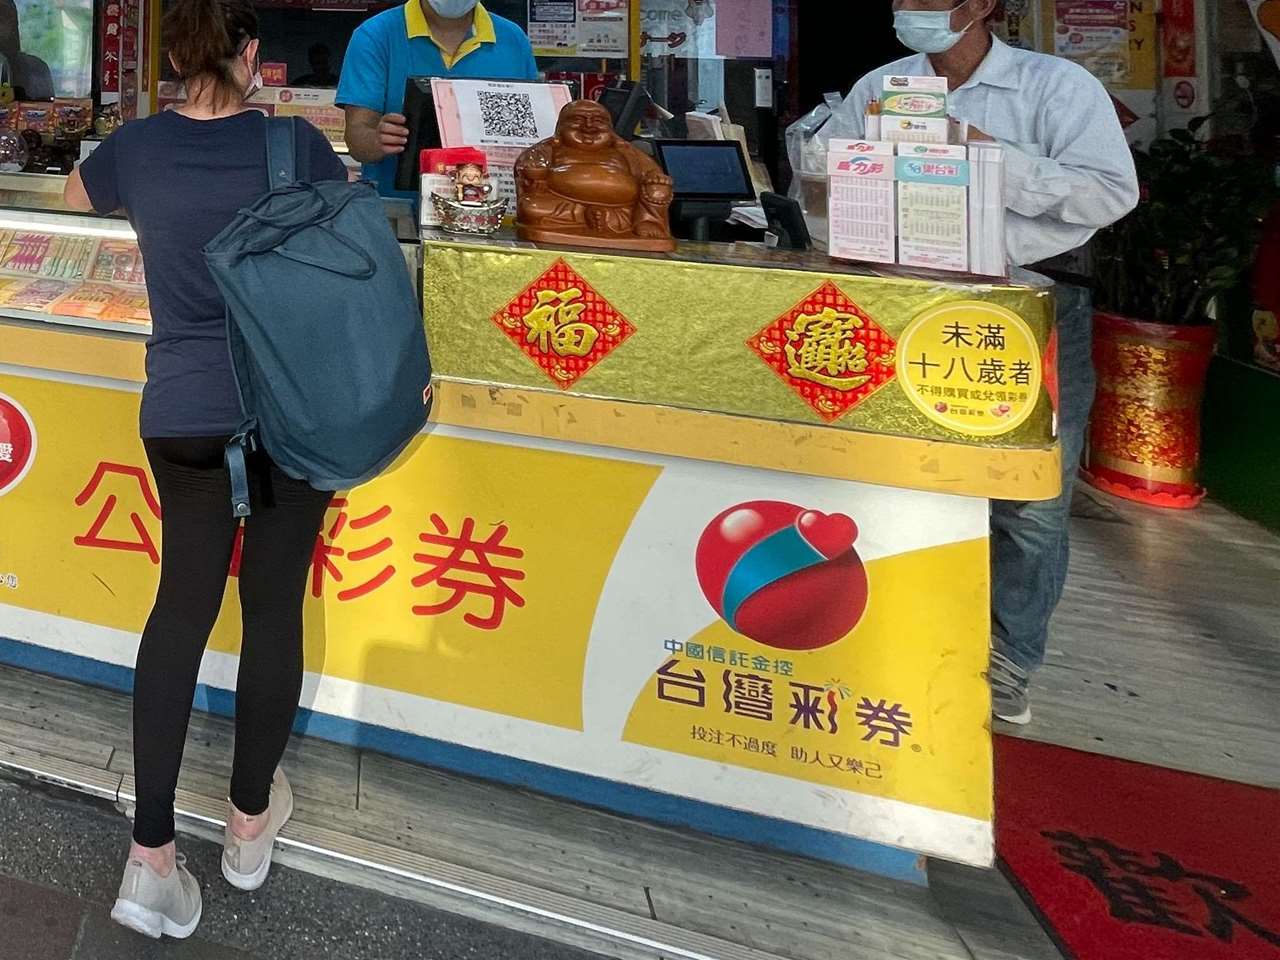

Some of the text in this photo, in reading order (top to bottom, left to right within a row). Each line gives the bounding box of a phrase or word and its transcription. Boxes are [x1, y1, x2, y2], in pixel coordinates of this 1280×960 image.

[523, 287, 599, 358] 福
[941, 320, 1006, 351] 未滿
[908, 352, 1033, 387] 十八歲者
[72, 461, 526, 632] 公彩券
[663, 639, 794, 677] 中國信託金控
[655, 659, 914, 748] 台灣彩券
[690, 724, 884, 780] 投注不過度 助人又樂己
